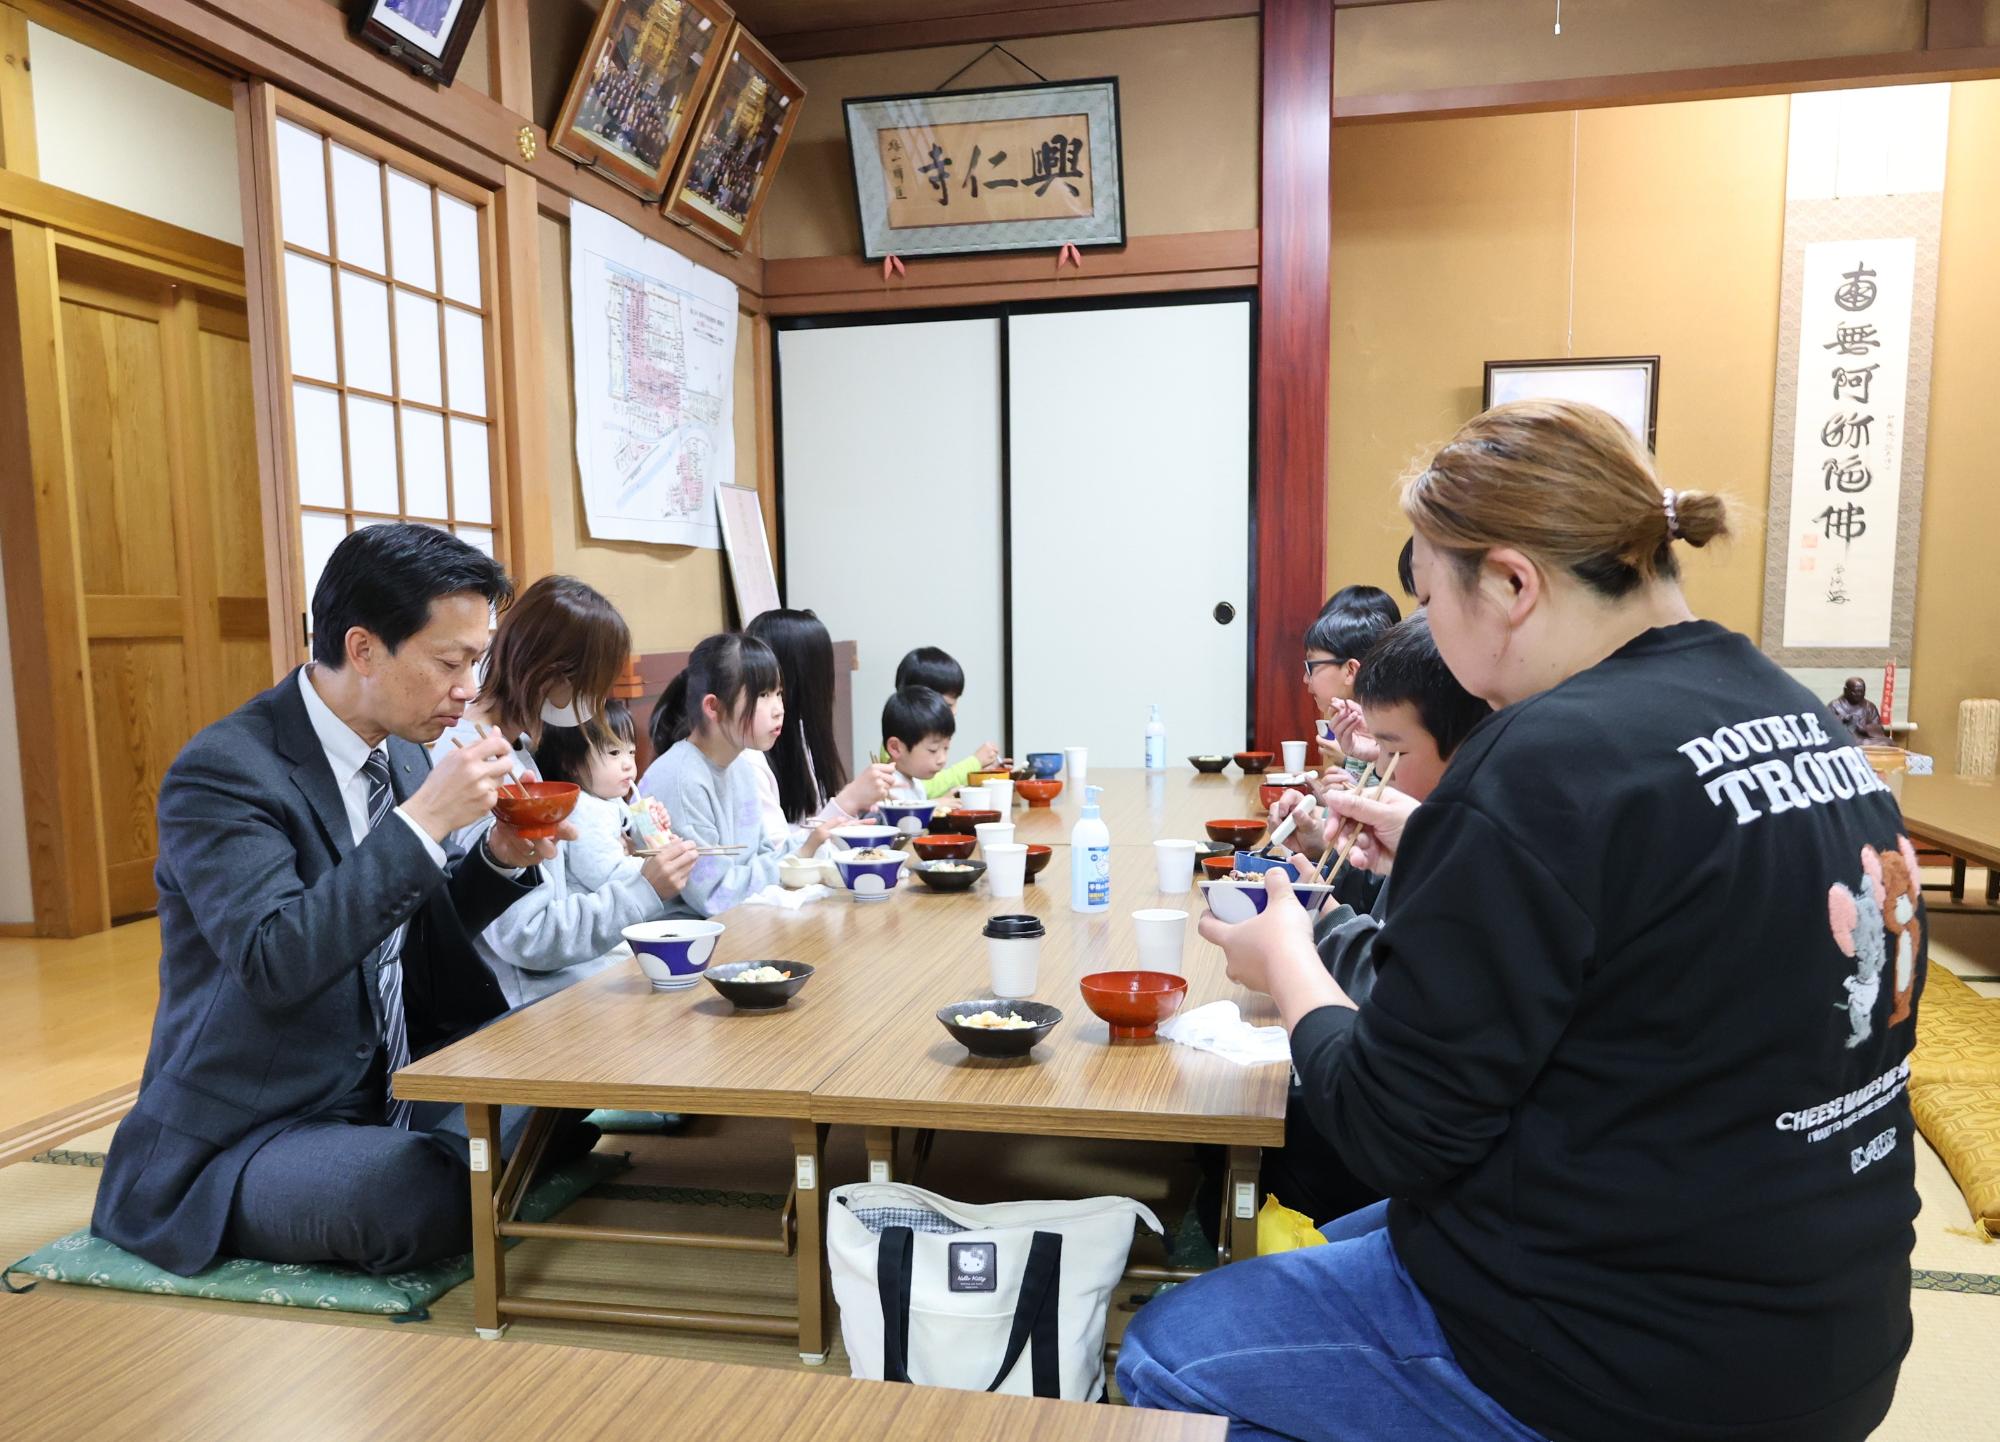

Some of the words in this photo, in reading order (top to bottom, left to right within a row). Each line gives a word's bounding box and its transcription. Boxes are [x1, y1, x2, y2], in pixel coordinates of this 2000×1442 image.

[1676, 712, 1832, 777] DOUBLE
[1704, 746, 1891, 825] TROUBL
[1775, 1097, 1843, 1131] CHEESE
